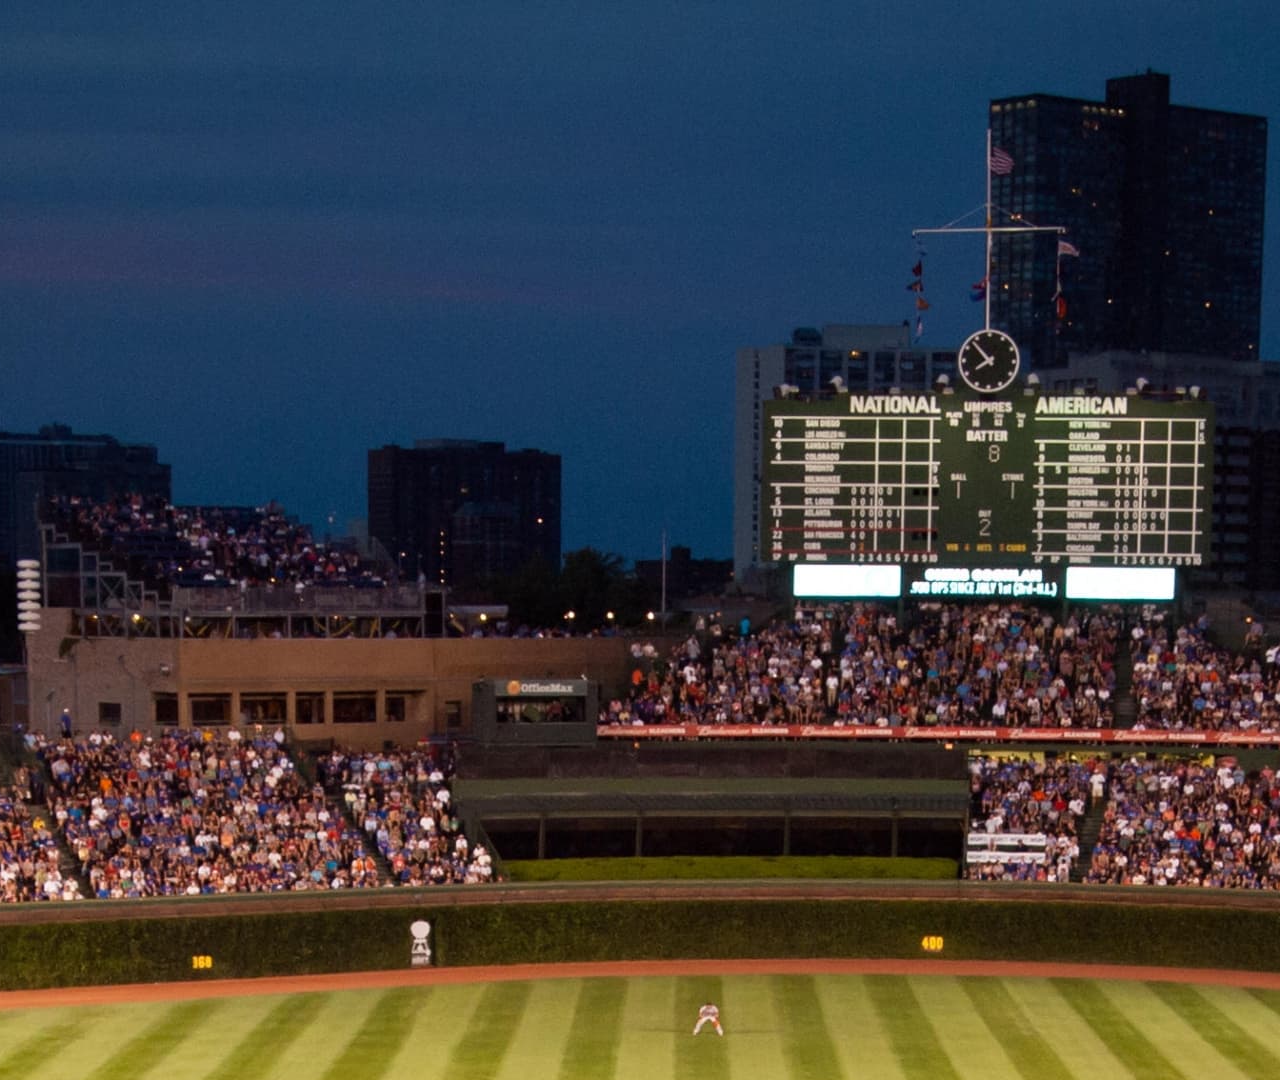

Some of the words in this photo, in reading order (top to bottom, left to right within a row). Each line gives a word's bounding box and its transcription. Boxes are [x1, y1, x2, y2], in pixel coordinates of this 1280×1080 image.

[850, 395, 941, 413] NATIONAL
[964, 402, 1012, 413] UMPIRES
[1035, 397, 1127, 414] AMERICAN
[966, 430, 1007, 441] BATTER
[989, 445, 1000, 462] 8
[979, 519, 991, 536] 2
[859, 554, 864, 562] 2
[868, 554, 873, 562] 3
[877, 554, 882, 562] 4
[886, 554, 891, 562] 5
[895, 554, 900, 562] 6
[904, 554, 909, 562] 7
[913, 554, 918, 562] 8
[922, 554, 927, 562] 9
[929, 554, 938, 562] 10
[950, 582, 974, 594] SINCE
[977, 583, 996, 594] JULY
[521, 683, 573, 692] OfficeMax
[922, 936, 943, 950] 400
